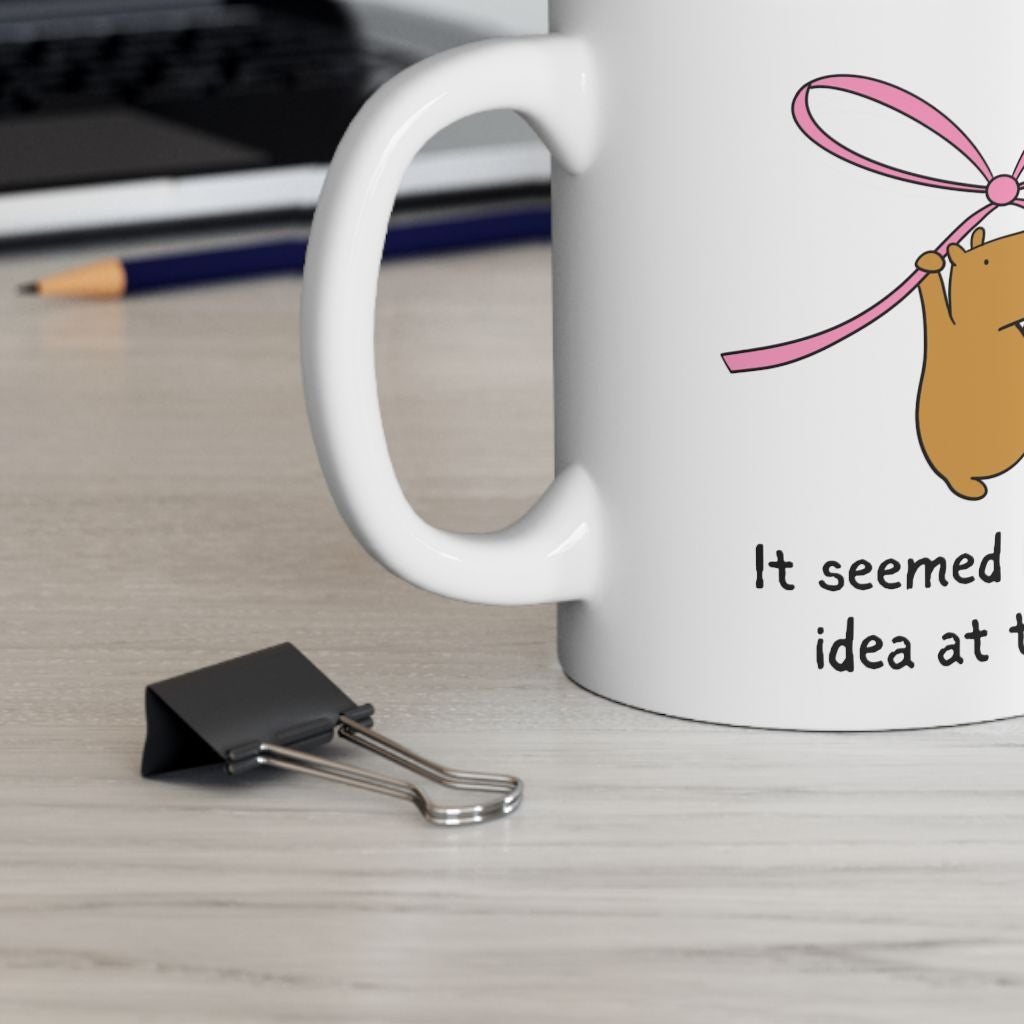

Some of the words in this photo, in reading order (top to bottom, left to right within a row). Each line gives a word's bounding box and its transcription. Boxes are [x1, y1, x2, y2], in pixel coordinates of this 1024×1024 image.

[756, 544, 795, 590] It
[819, 532, 1001, 591] seemed
[817, 617, 914, 672] idea
[938, 619, 989, 666] at
